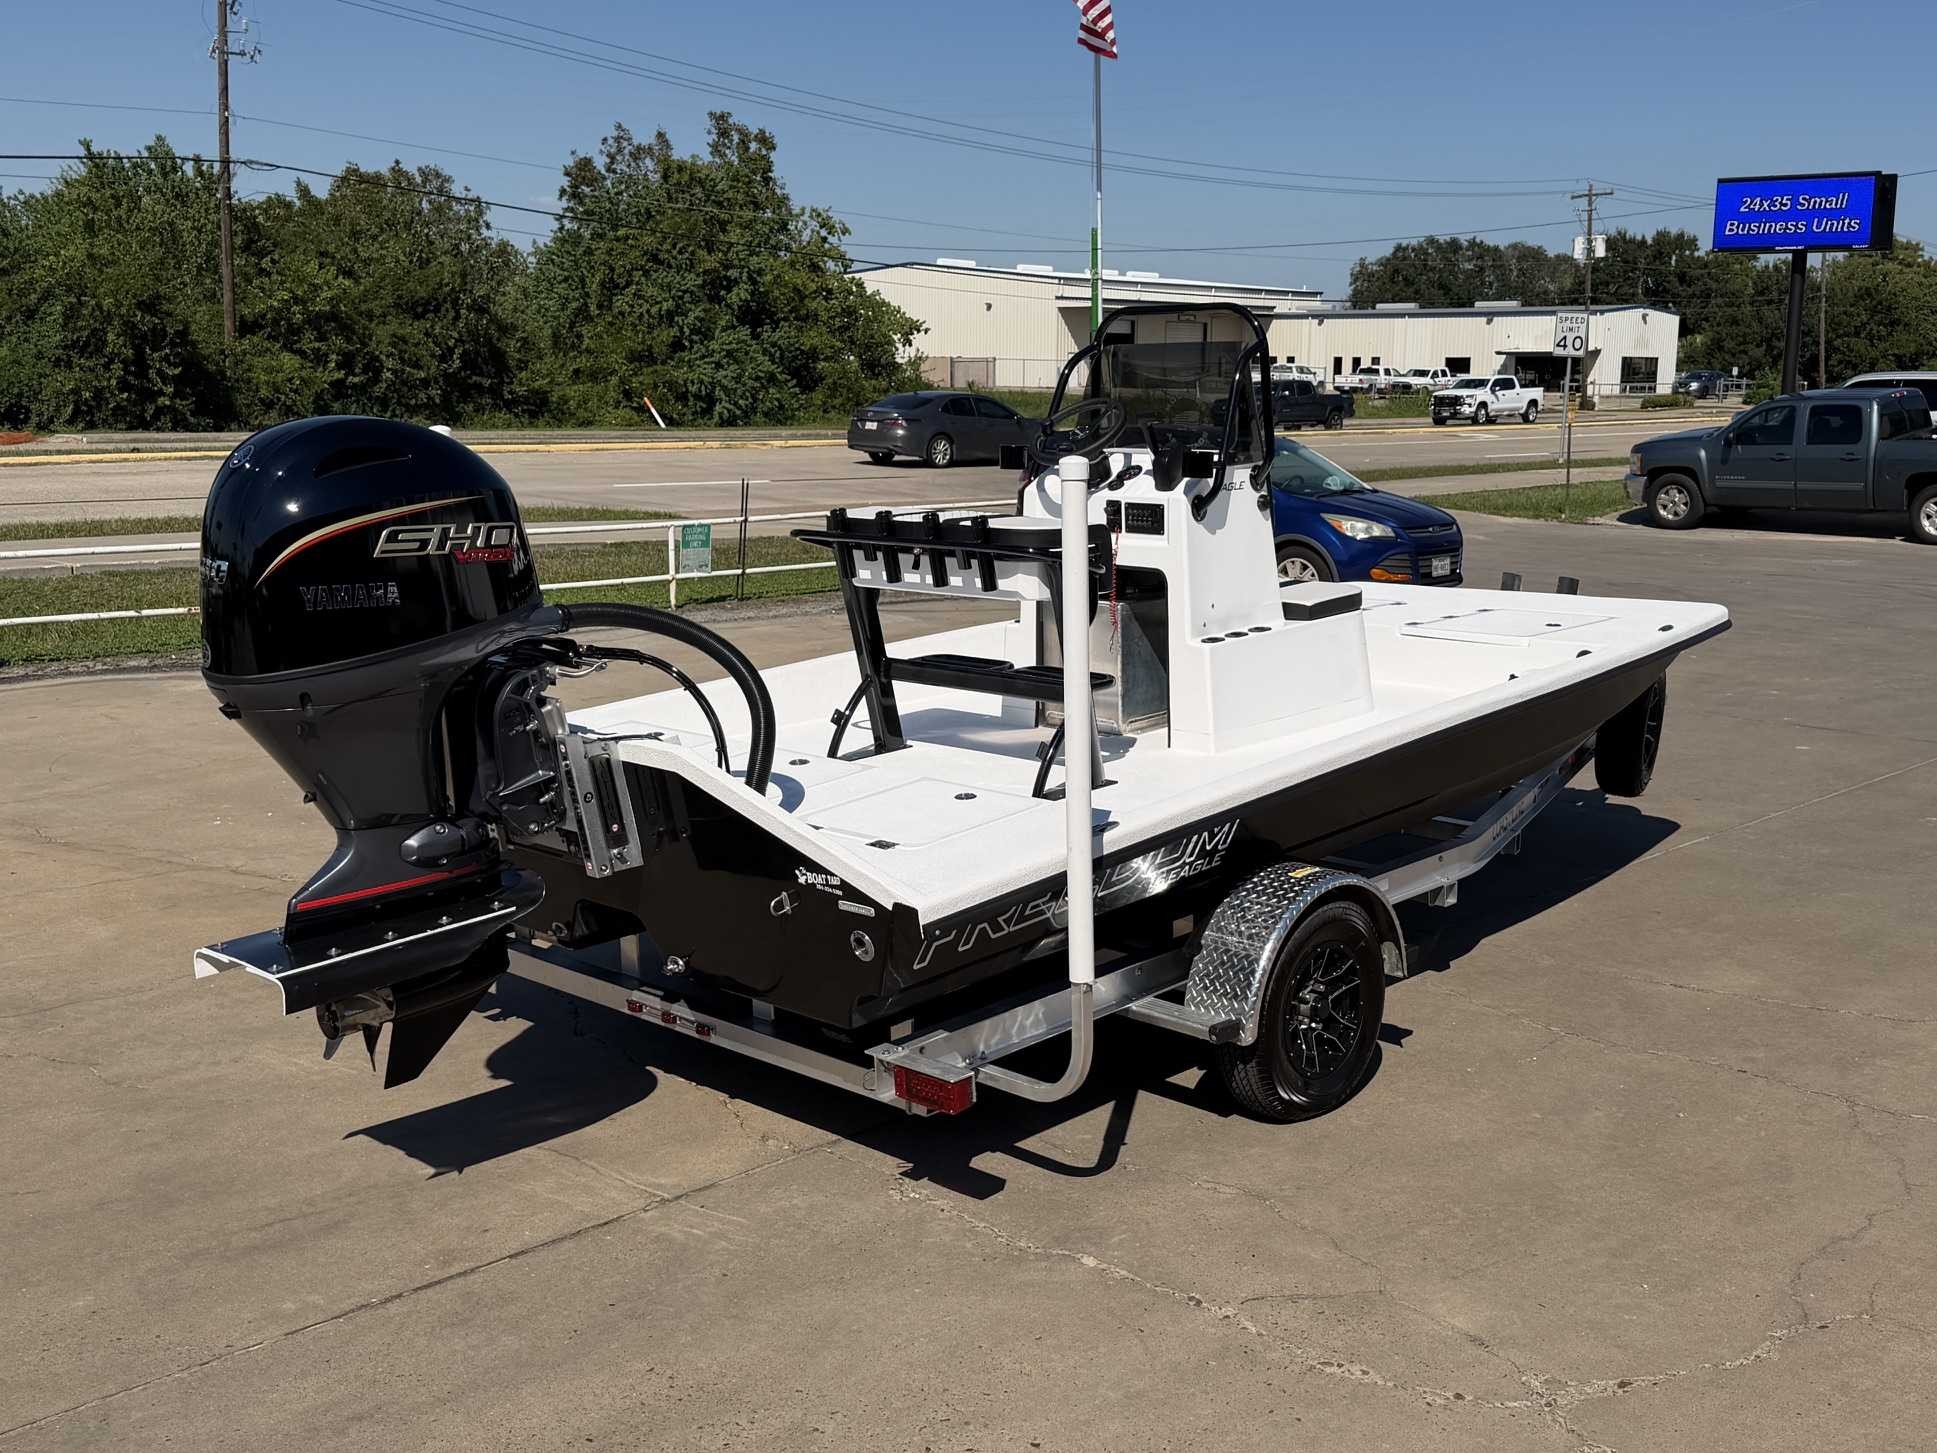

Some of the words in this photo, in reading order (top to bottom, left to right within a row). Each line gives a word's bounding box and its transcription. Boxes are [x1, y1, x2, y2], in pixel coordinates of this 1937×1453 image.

[1740, 195, 1792, 212] 24x35
[1796, 192, 1849, 210] Small
[1725, 218, 1807, 235] Business
[1812, 215, 1860, 232] Units
[1558, 316, 1585, 324] SPEED
[1561, 325, 1581, 334] LIMIT
[1555, 335, 1584, 352] 40
[1221, 481, 1245, 491] AGLE
[374, 522, 518, 559] SHO
[299, 582, 402, 612] YAMAHA
[1165, 850, 1227, 885] EAGLE
[806, 871, 827, 885] BOAT
